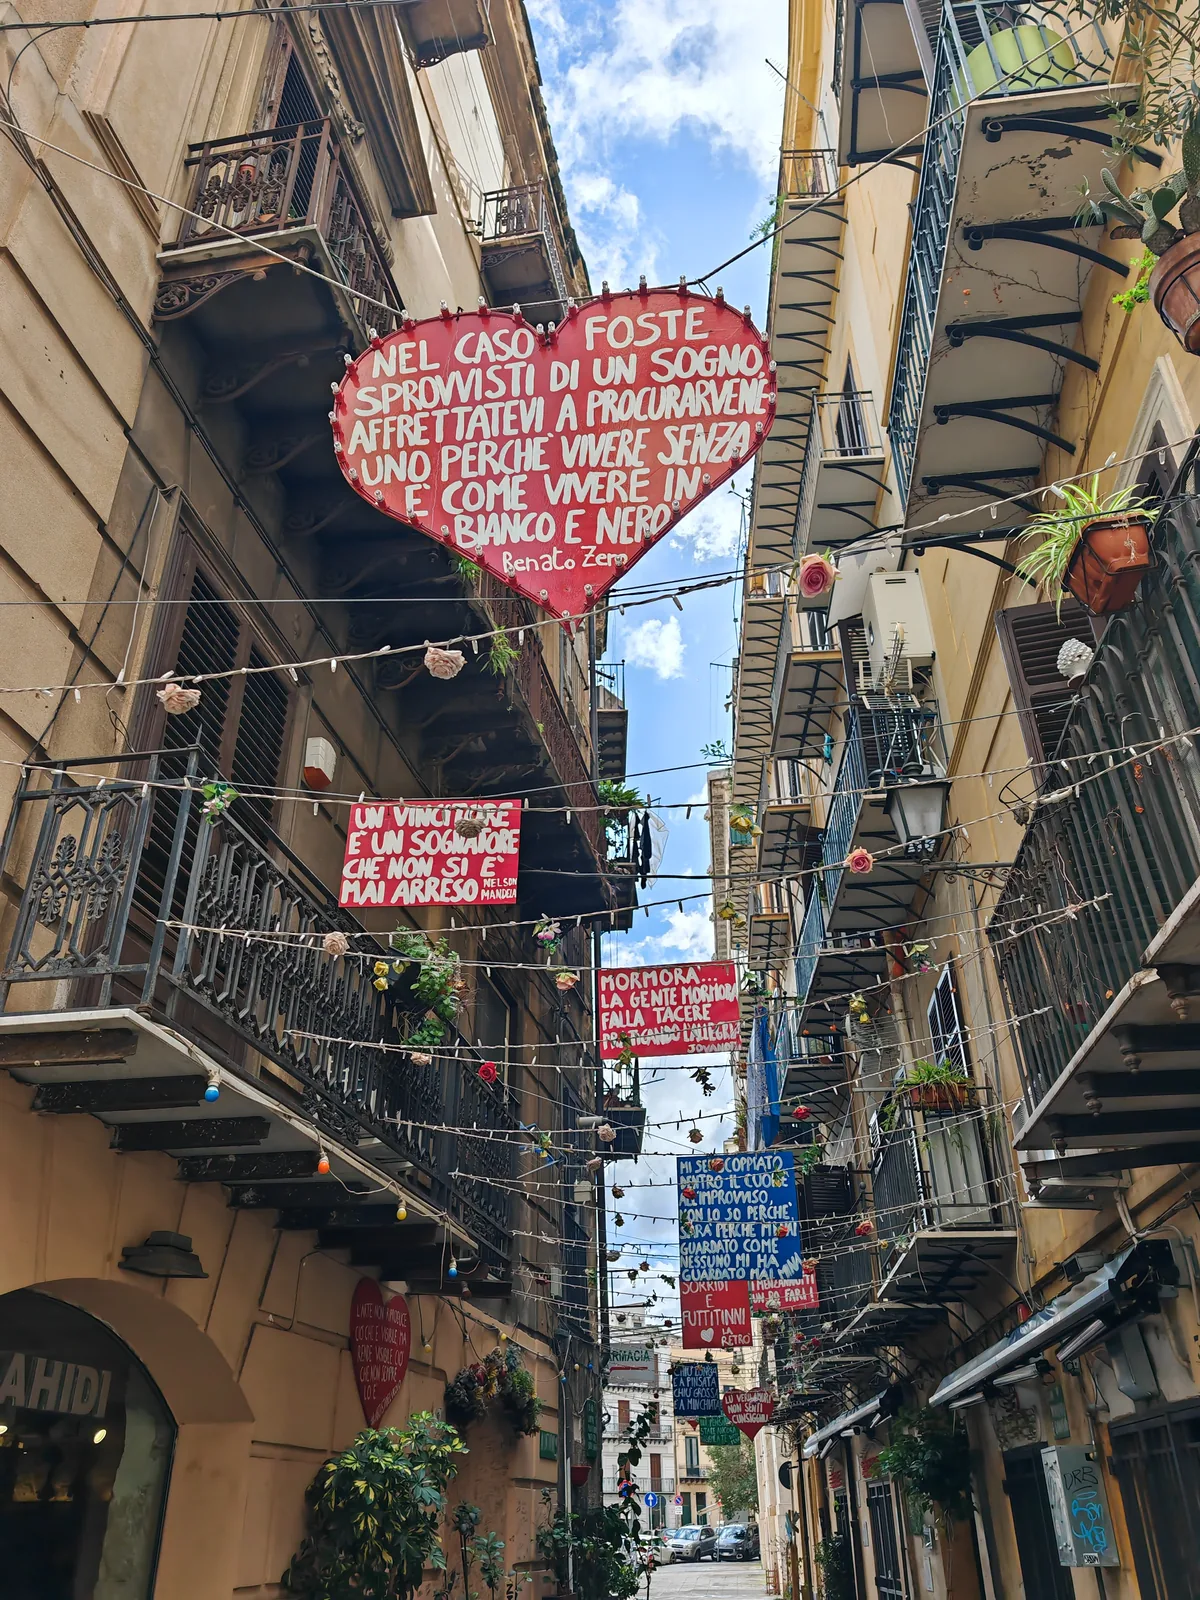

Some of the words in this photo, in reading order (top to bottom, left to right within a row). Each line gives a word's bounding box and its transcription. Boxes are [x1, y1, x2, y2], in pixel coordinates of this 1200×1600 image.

[372, 341, 439, 378] NEL
[454, 328, 535, 364] CASO
[585, 306, 709, 350] FOSTE
[354, 362, 534, 416] SPROVVISTI
[550, 360, 579, 392] DI
[593, 354, 637, 385] UN
[348, 396, 544, 455] AFFRETTATEVI
[555, 394, 578, 432] A
[586, 379, 770, 426] PROCURARVENE
[361, 450, 430, 486] UNO
[560, 427, 646, 468] VIVERE
[657, 421, 750, 465] SENZA
[441, 474, 528, 515] COME
[544, 467, 649, 505] VIVERE
[664, 466, 701, 501] IN
[454, 511, 555, 548] BIANCO
[565, 512, 582, 543] E
[595, 504, 671, 544] NERO
[502, 548, 575, 573] Renato
[580, 545, 628, 567] Zero
[354, 807, 384, 829] UN
[393, 802, 513, 828] VINCITORE
[371, 829, 404, 855] UN
[409, 828, 520, 856] SOGNATORE
[342, 856, 384, 879] CHE
[387, 856, 433, 880] NON
[440, 857, 468, 878] SI
[340, 879, 385, 905] MAI
[390, 877, 479, 905] ARRESO
[483, 877, 517, 888] NELSON
[481, 888, 517, 900] MANDELA
[601, 967, 718, 991] MORMORA...
[601, 992, 624, 1009] LA
[630, 987, 677, 1008] GENTE
[682, 982, 738, 1005] MORMORA
[602, 1008, 645, 1031] FALLA
[652, 1003, 712, 1024] TACERE
[680, 1161, 692, 1174] MI
[718, 1156, 783, 1173] COPPIATO
[680, 1174, 723, 1190] DENTRO
[729, 1174, 741, 1189] IL
[707, 1208, 720, 1221] LO
[725, 1207, 740, 1221] SO
[780, 1221, 797, 1238] AI
[680, 1238, 738, 1256] GUARDATO
[743, 1238, 779, 1254] COME
[680, 1254, 731, 1269] NESSUNO
[736, 1253, 750, 1268] MI
[757, 1253, 779, 1268] HA
[681, 1267, 746, 1281] GUARDATO
[750, 1266, 774, 1280] MAL
[682, 1280, 728, 1294] SORRIDI
[706, 1293, 715, 1308] E
[682, 1307, 745, 1327] FUTTITINNI
[721, 1327, 733, 1335] LA
[727, 1404, 742, 1414] NON
